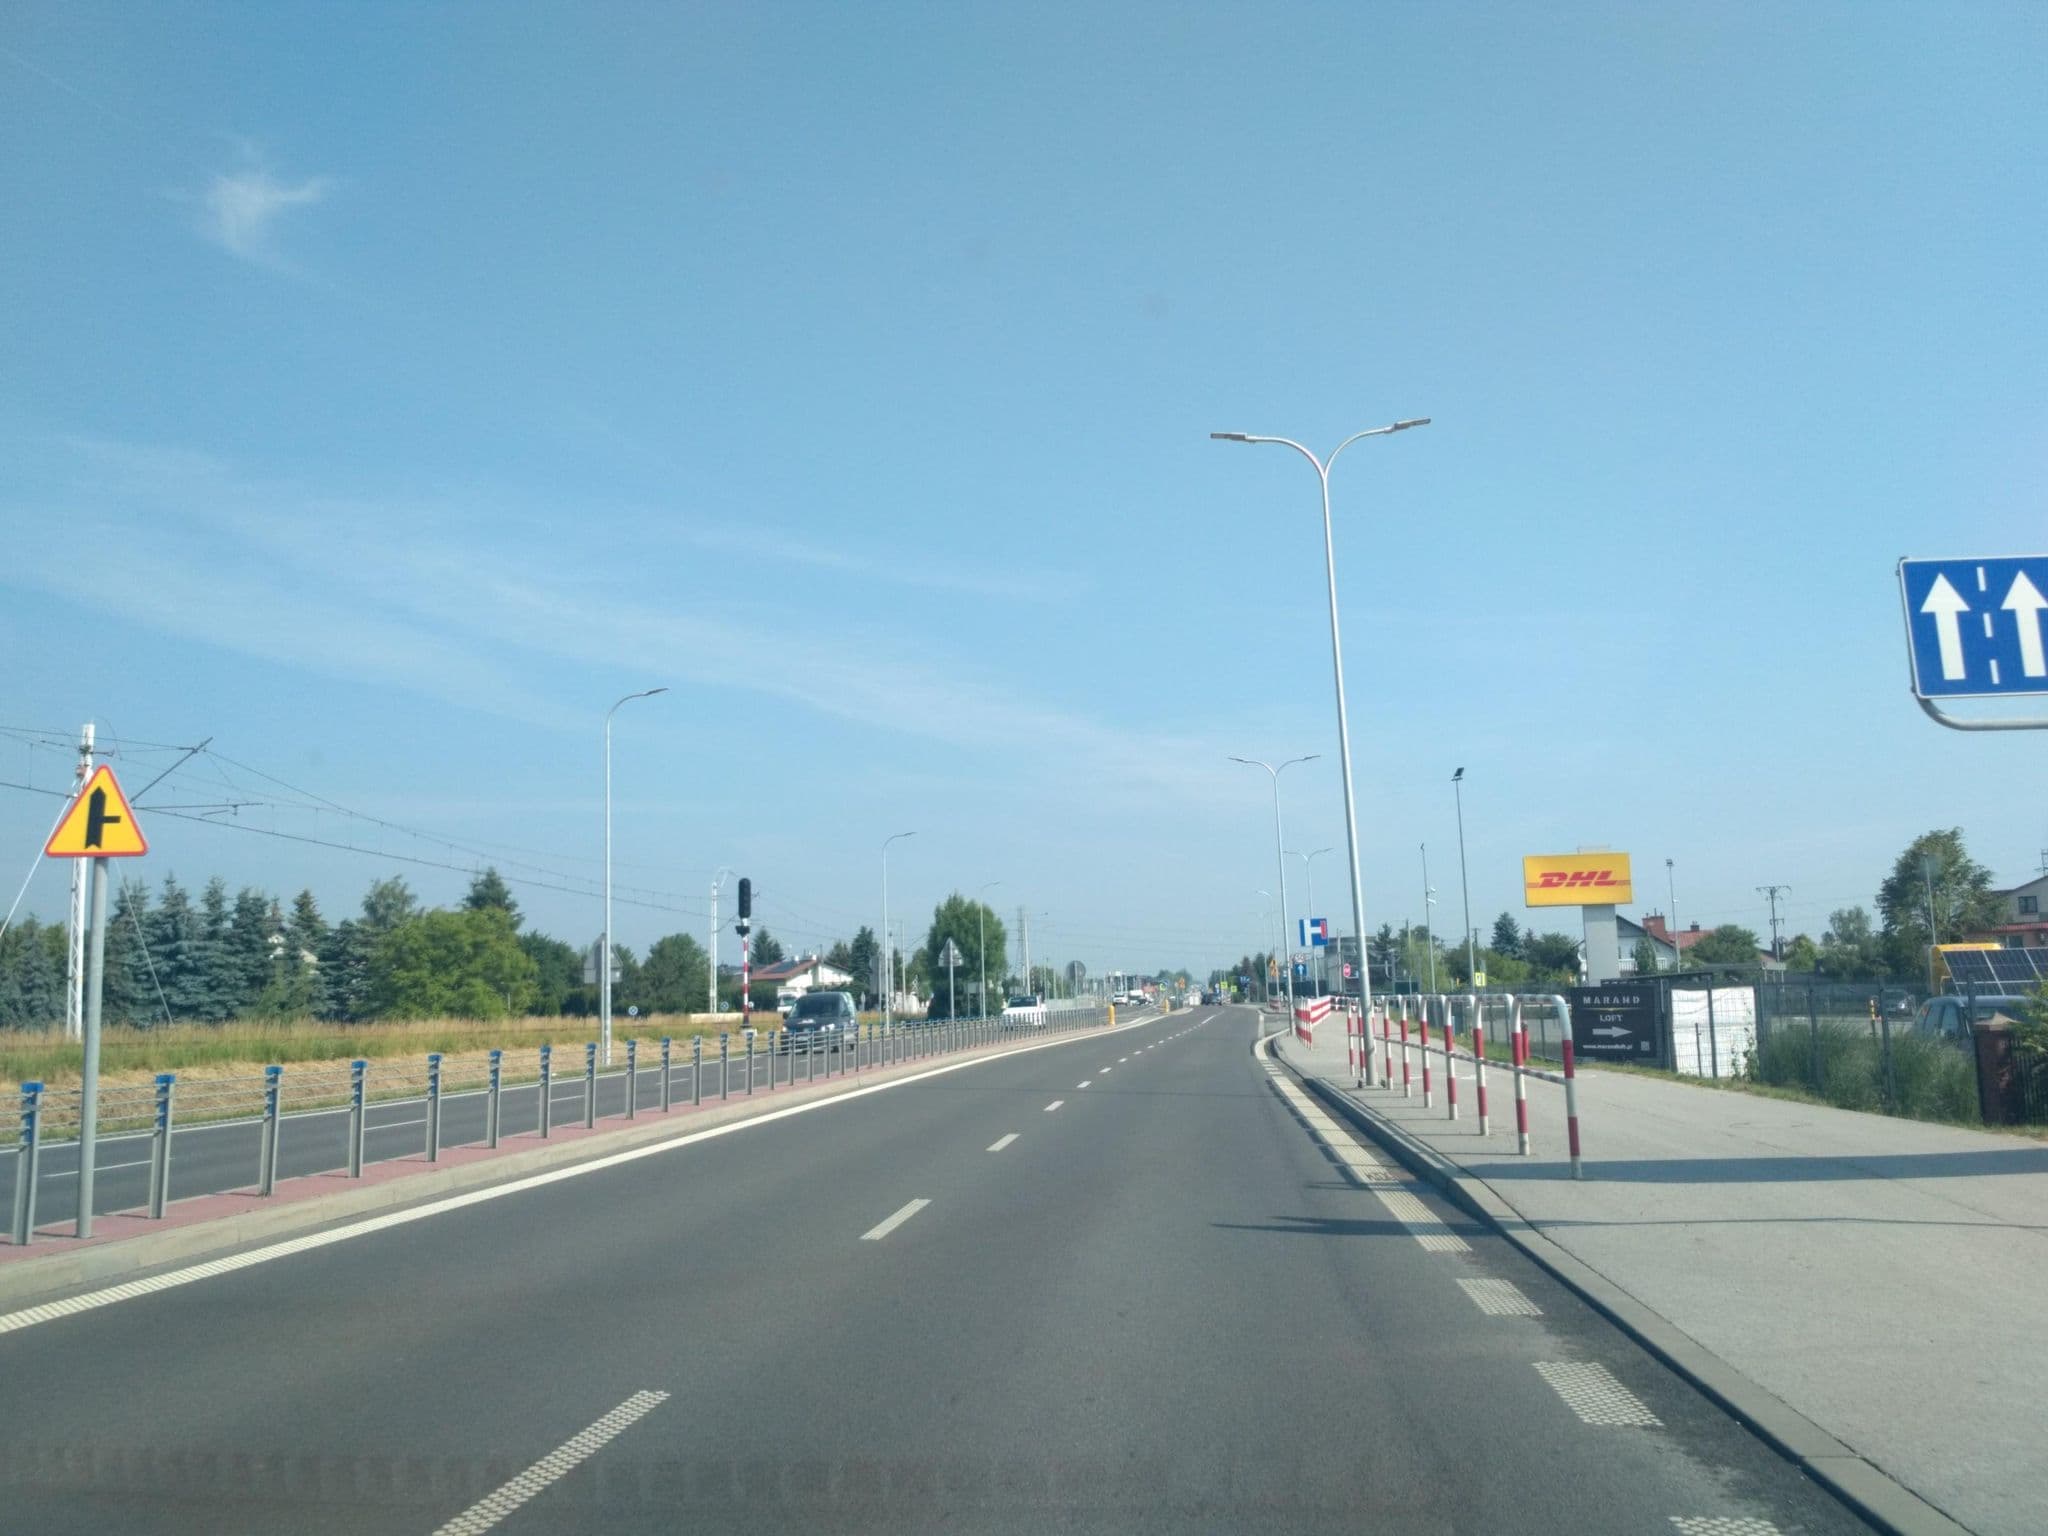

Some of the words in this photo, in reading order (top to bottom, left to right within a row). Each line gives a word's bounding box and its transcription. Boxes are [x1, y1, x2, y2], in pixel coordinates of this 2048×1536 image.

[1539, 870, 1617, 888] DHL
[1583, 996, 1640, 1004] MARAND
[1600, 1014, 1622, 1022] LOFT
